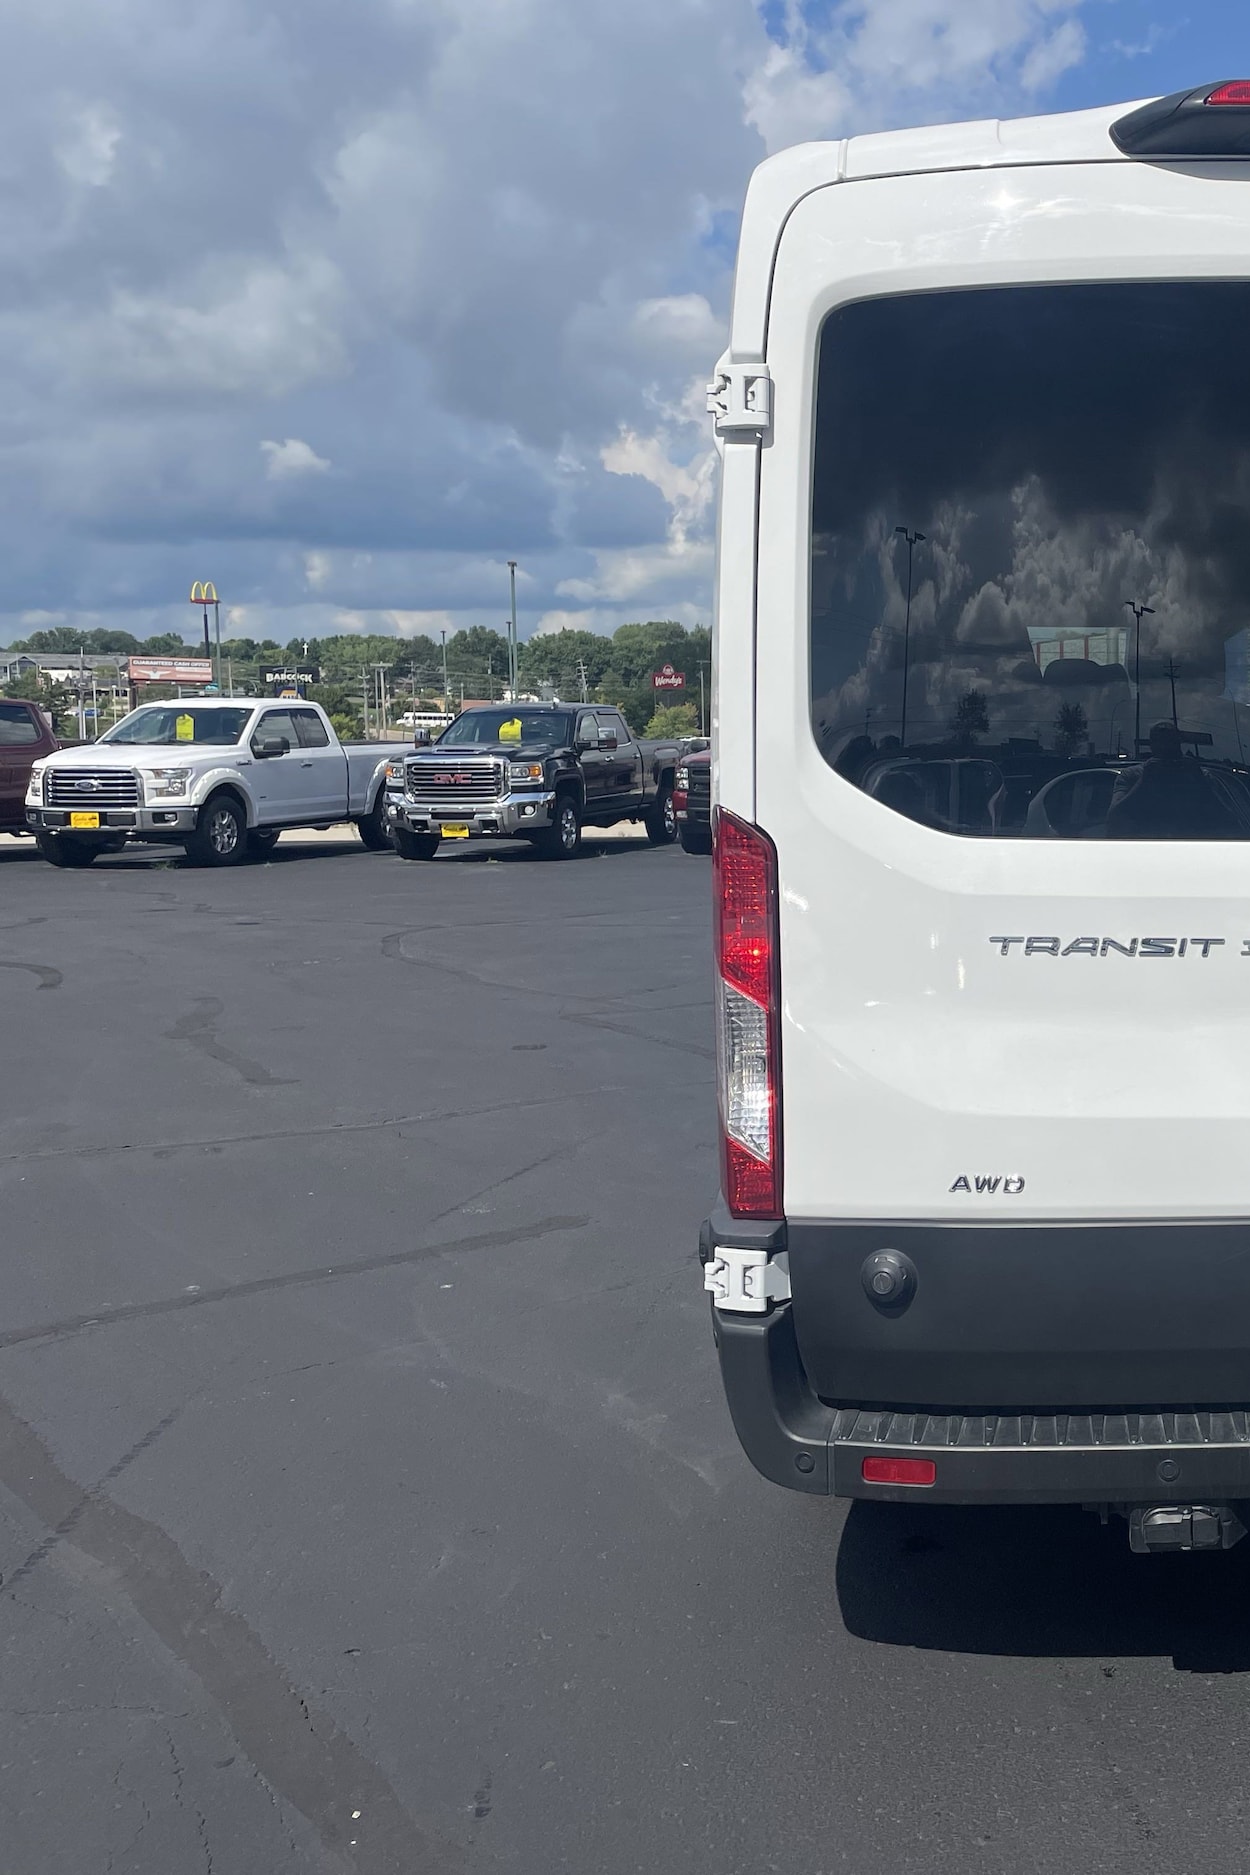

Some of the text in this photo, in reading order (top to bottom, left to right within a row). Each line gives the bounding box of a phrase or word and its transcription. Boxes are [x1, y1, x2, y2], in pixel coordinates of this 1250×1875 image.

[433, 773, 472, 784] GMC
[989, 936, 1226, 958] TRANSIT
[948, 1175, 1026, 1194] AWD
